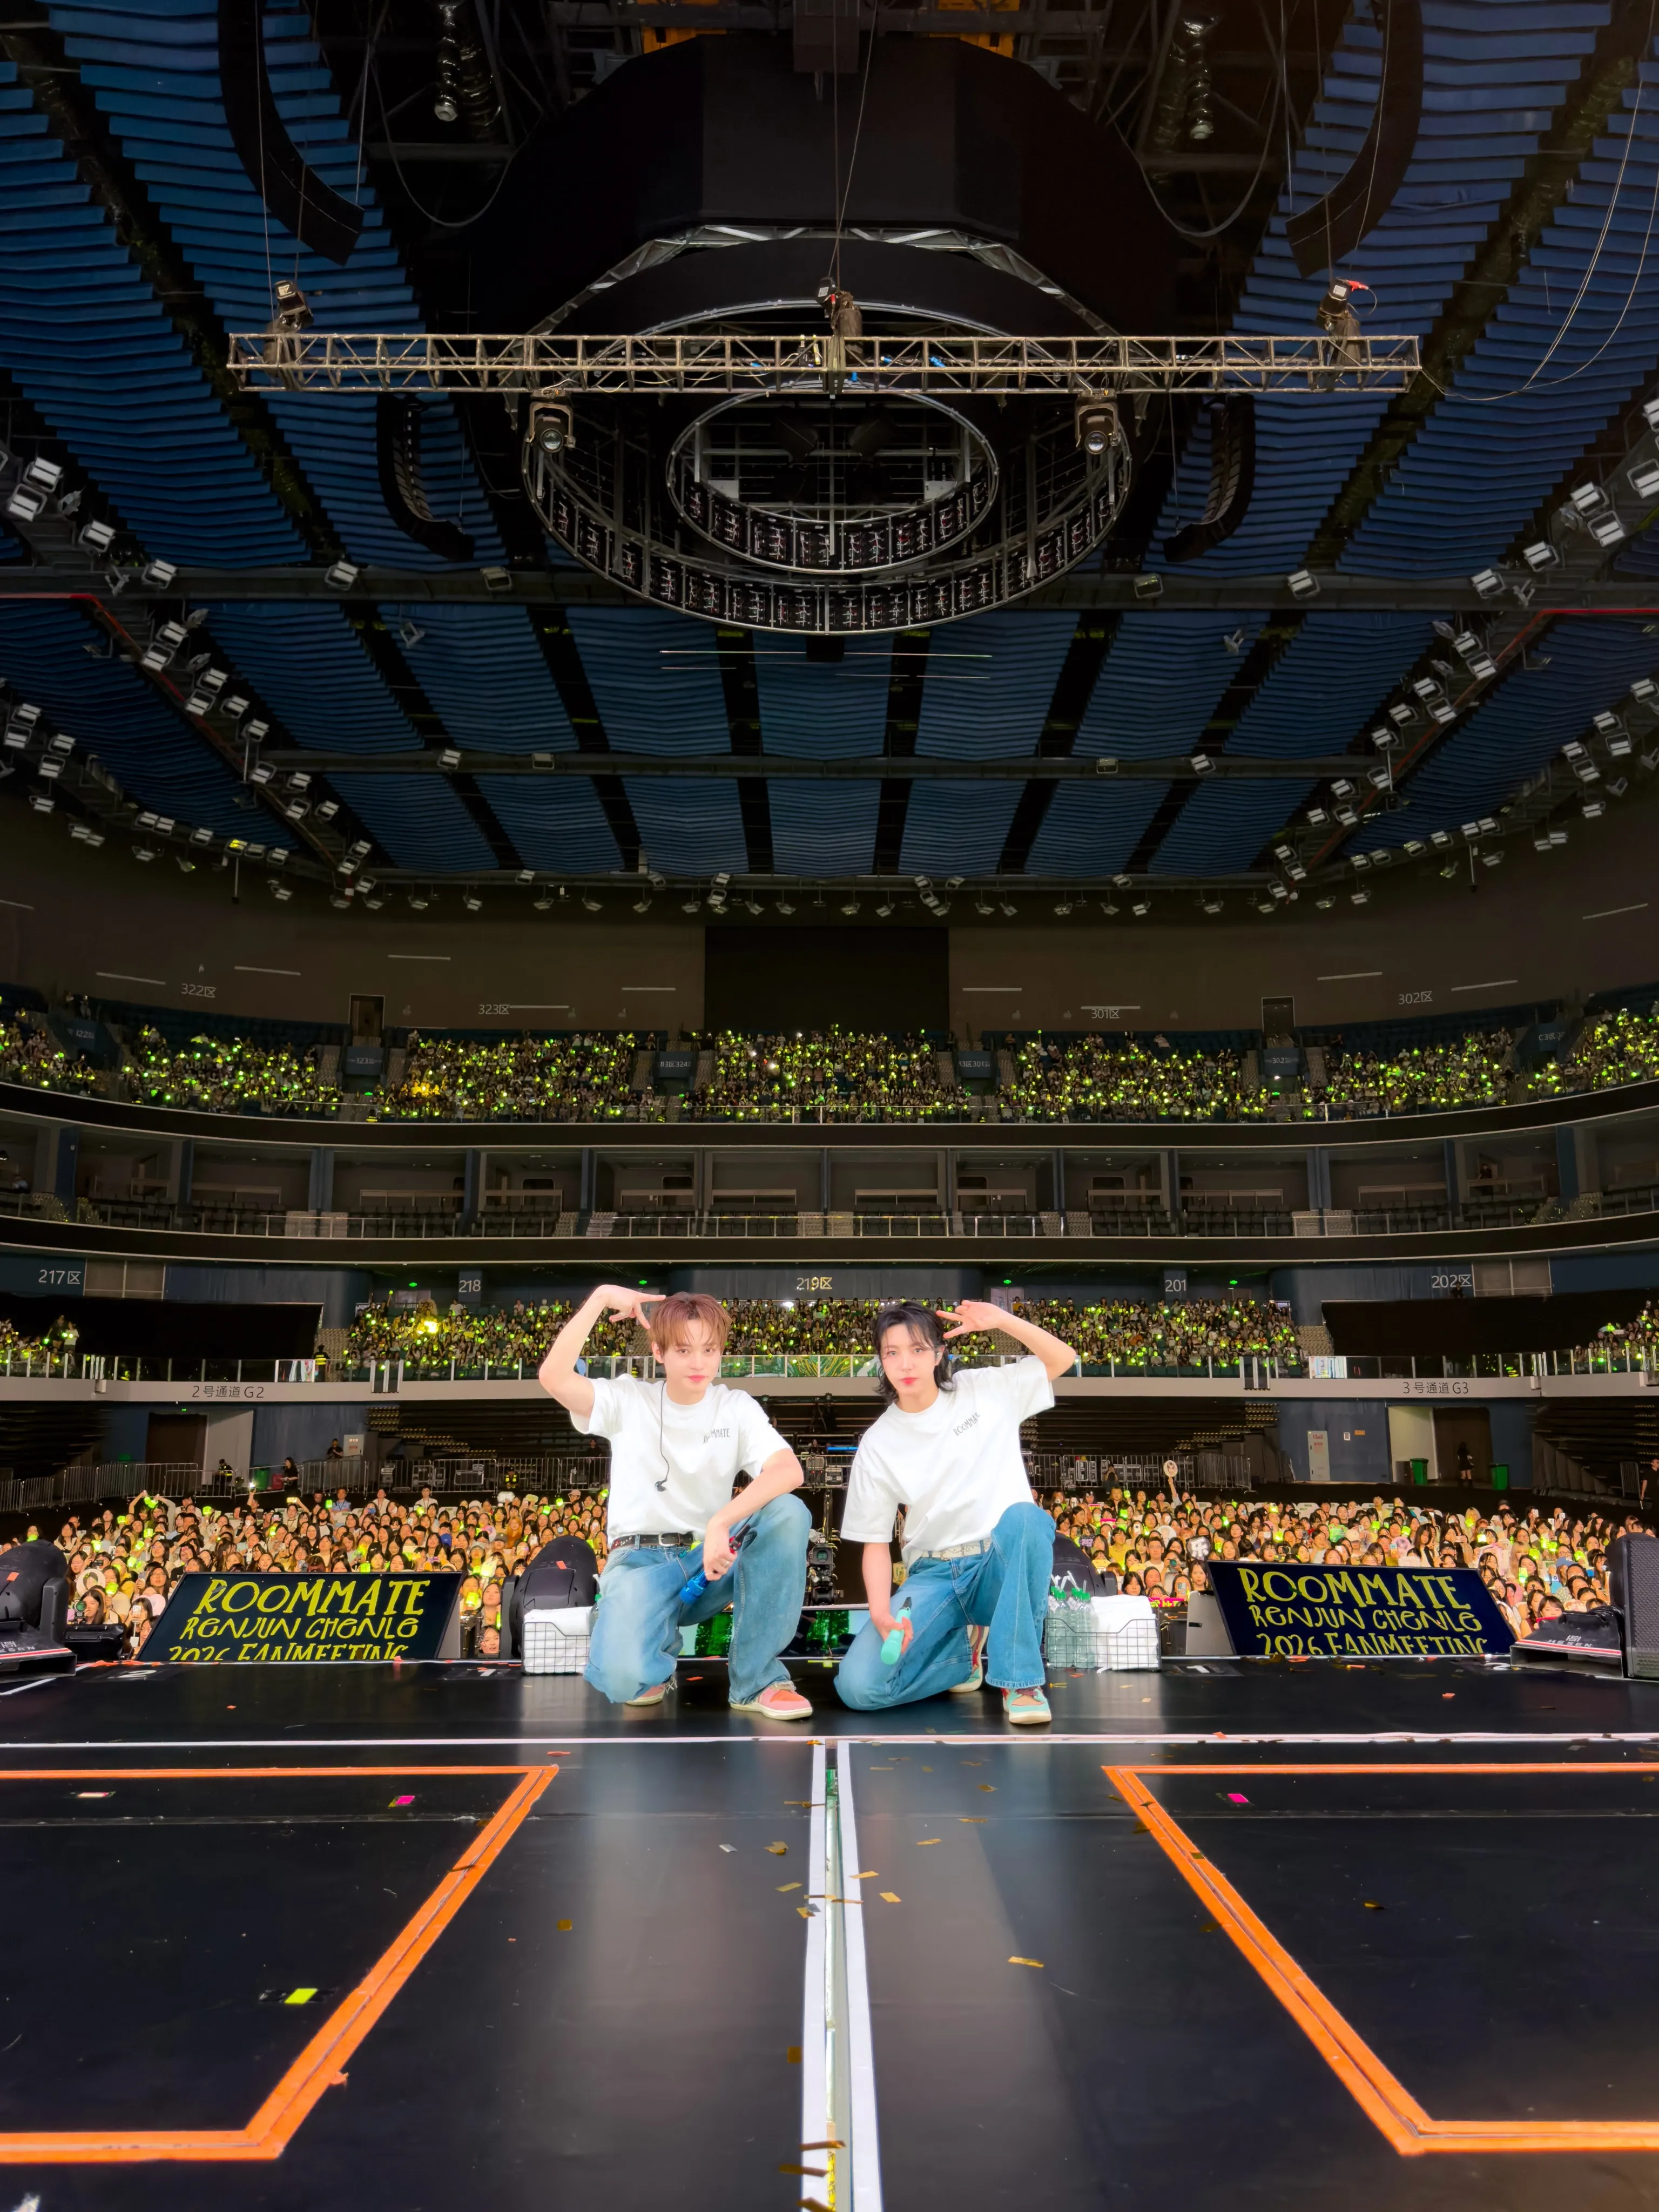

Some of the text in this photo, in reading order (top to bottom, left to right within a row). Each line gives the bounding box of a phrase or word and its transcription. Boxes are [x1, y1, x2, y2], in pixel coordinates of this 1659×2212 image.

[181, 983, 217, 998] 322区
[1398, 990, 1433, 1004] 302区
[478, 1004, 510, 1015] 323区
[1091, 1008, 1120, 1019] 301区
[38, 1269, 82, 1284] 217区
[1432, 1274, 1472, 1288] 202区
[458, 1279, 481, 1292] 218
[797, 1277, 833, 1291] 219区
[1165, 1279, 1186, 1292] 201
[192, 1385, 264, 1398] 2号通道 G2
[1403, 1381, 1468, 1394] 3号通道 G3
[953, 1412, 980, 1437] ROOMMAT
[703, 1428, 730, 1444] RMMATE
[1237, 1568, 1471, 1609] ROOMMATE
[193, 1579, 430, 1616] ROOMMATE
[1548, 1639, 1592, 1647] HESEN
